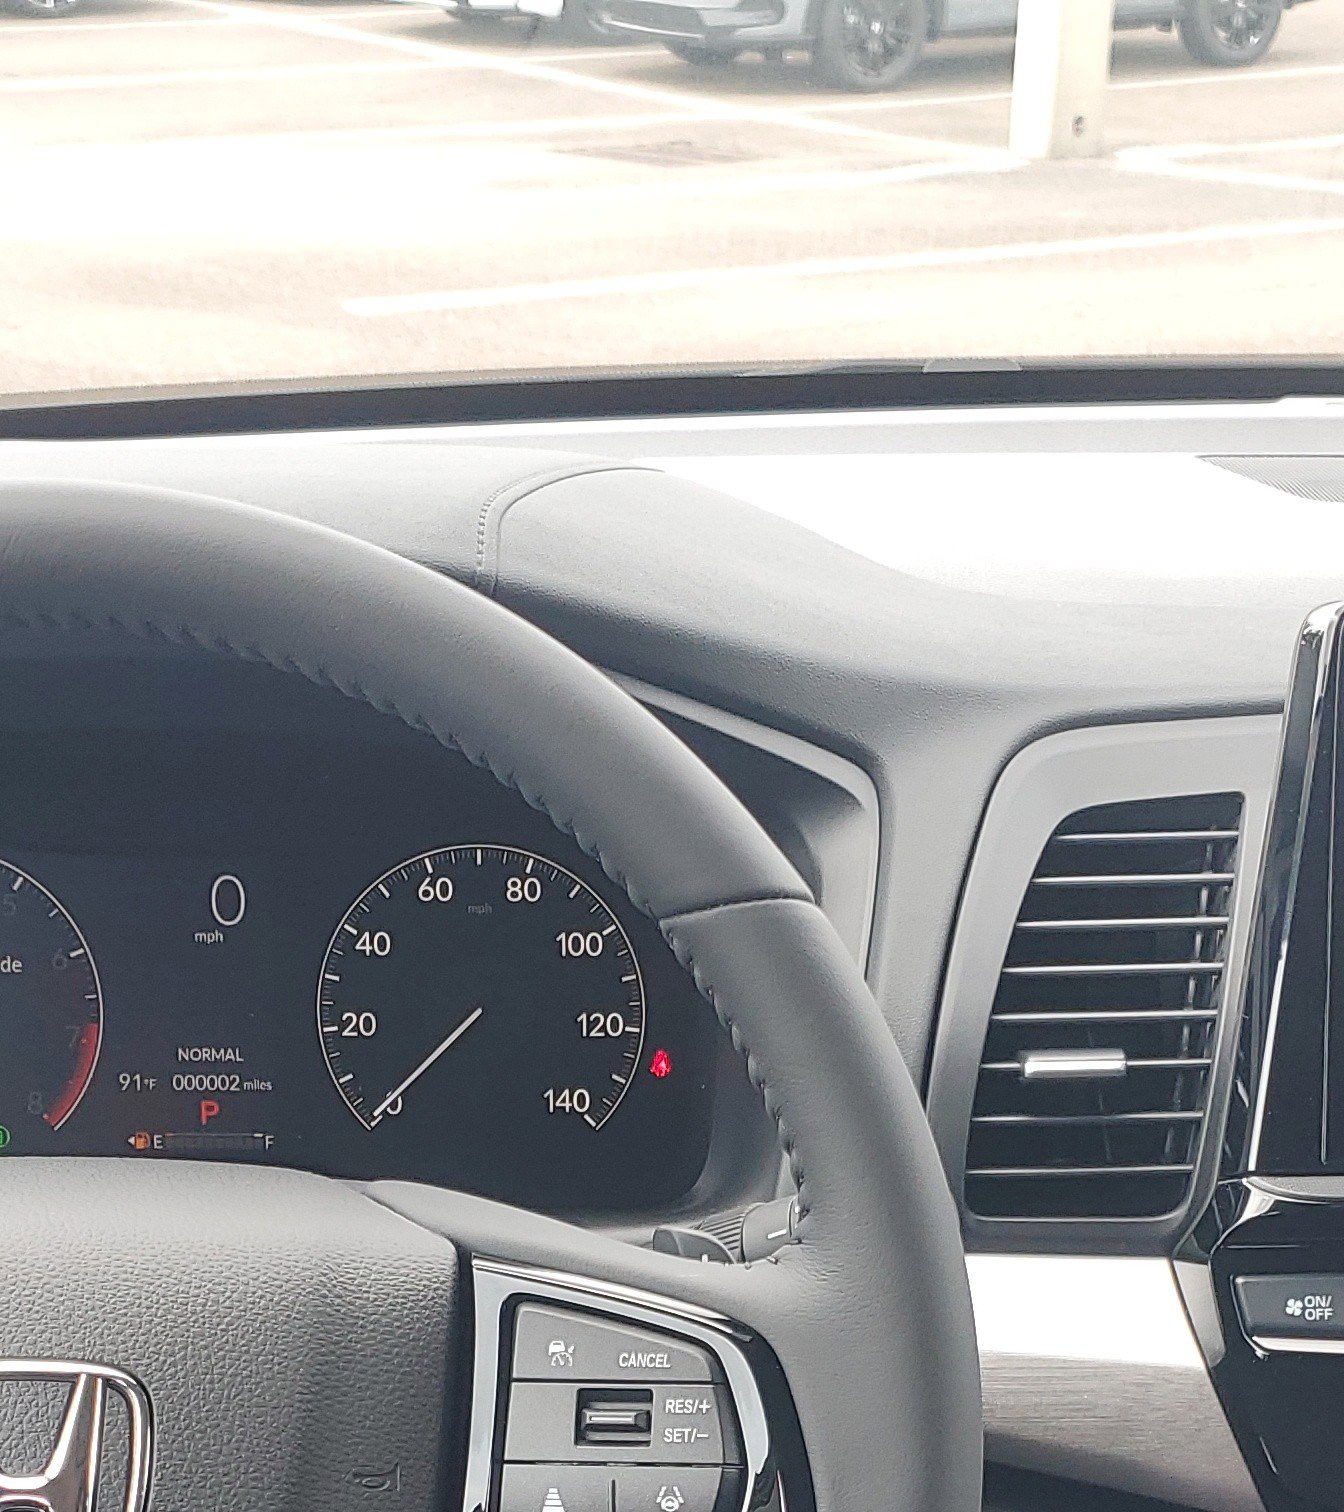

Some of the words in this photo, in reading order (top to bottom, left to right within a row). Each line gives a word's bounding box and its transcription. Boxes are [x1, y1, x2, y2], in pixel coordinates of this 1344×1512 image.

[417, 877, 454, 902] 60
[505, 877, 542, 903] 80
[211, 874, 246, 926] 0
[467, 903, 493, 916] mph
[194, 930, 224, 946] mph
[355, 931, 391, 957] 40
[555, 931, 604, 957] 100
[341, 1011, 378, 1037] 20
[576, 1011, 625, 1037] 120
[177, 1047, 245, 1063] NORMAL
[172, 1073, 241, 1092] 000002
[243, 1078, 273, 1091] miles
[543, 1088, 591, 1114] 140
[200, 1099, 220, 1126] P
[153, 1133, 164, 1149] E
[264, 1134, 275, 1150] F
[1304, 1294, 1332, 1309] ON/
[1304, 1308, 1334, 1322] OFF
[618, 1352, 672, 1369] CANCEL
[665, 1398, 711, 1415] RES/+
[662, 1427, 709, 1444] SET/-
